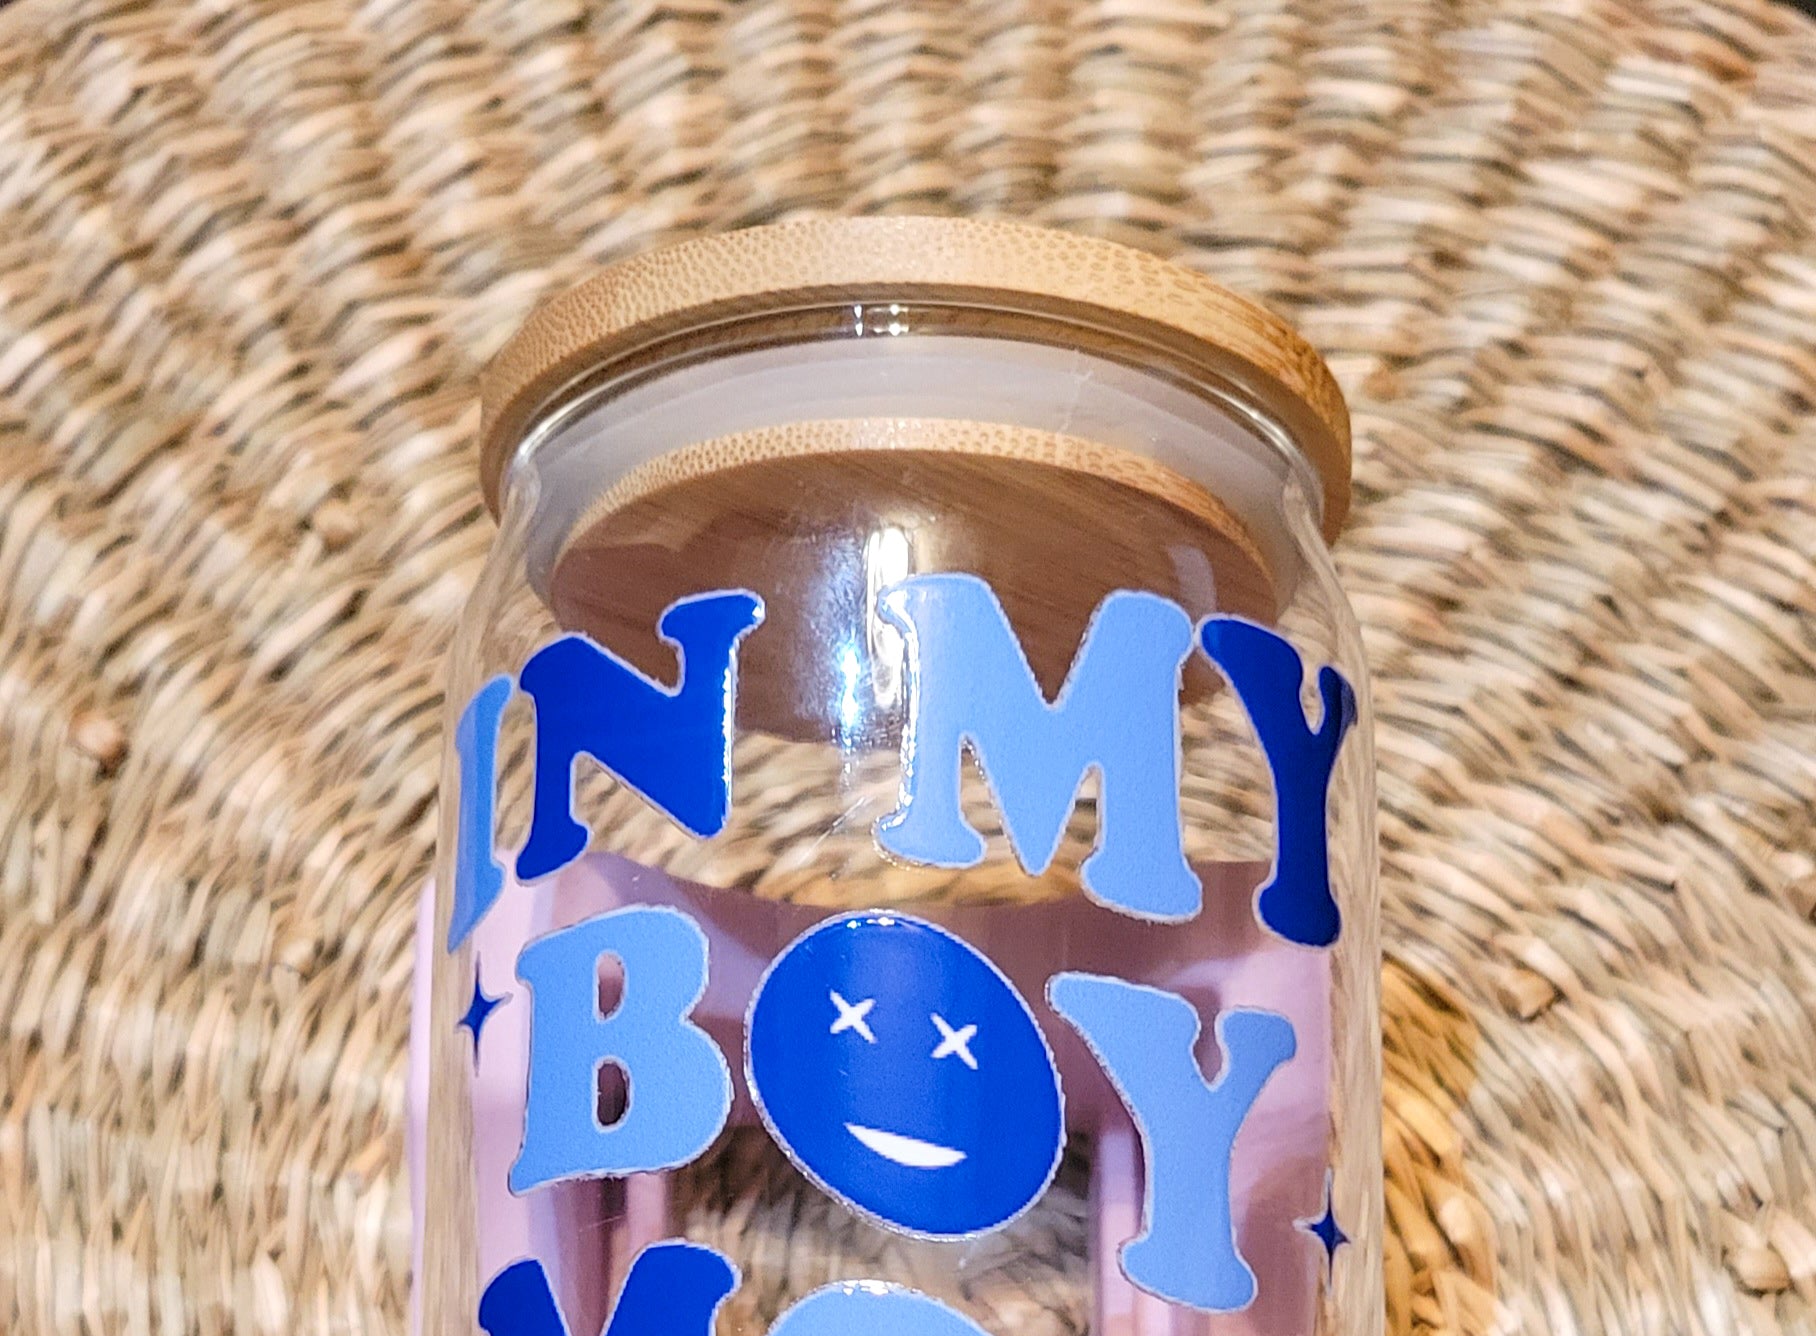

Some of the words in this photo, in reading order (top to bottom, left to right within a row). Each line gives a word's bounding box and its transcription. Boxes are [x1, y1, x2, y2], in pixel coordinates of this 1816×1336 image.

[447, 588, 765, 953] IN
[873, 573, 1357, 949] MY
[507, 908, 1299, 1312] BOY
